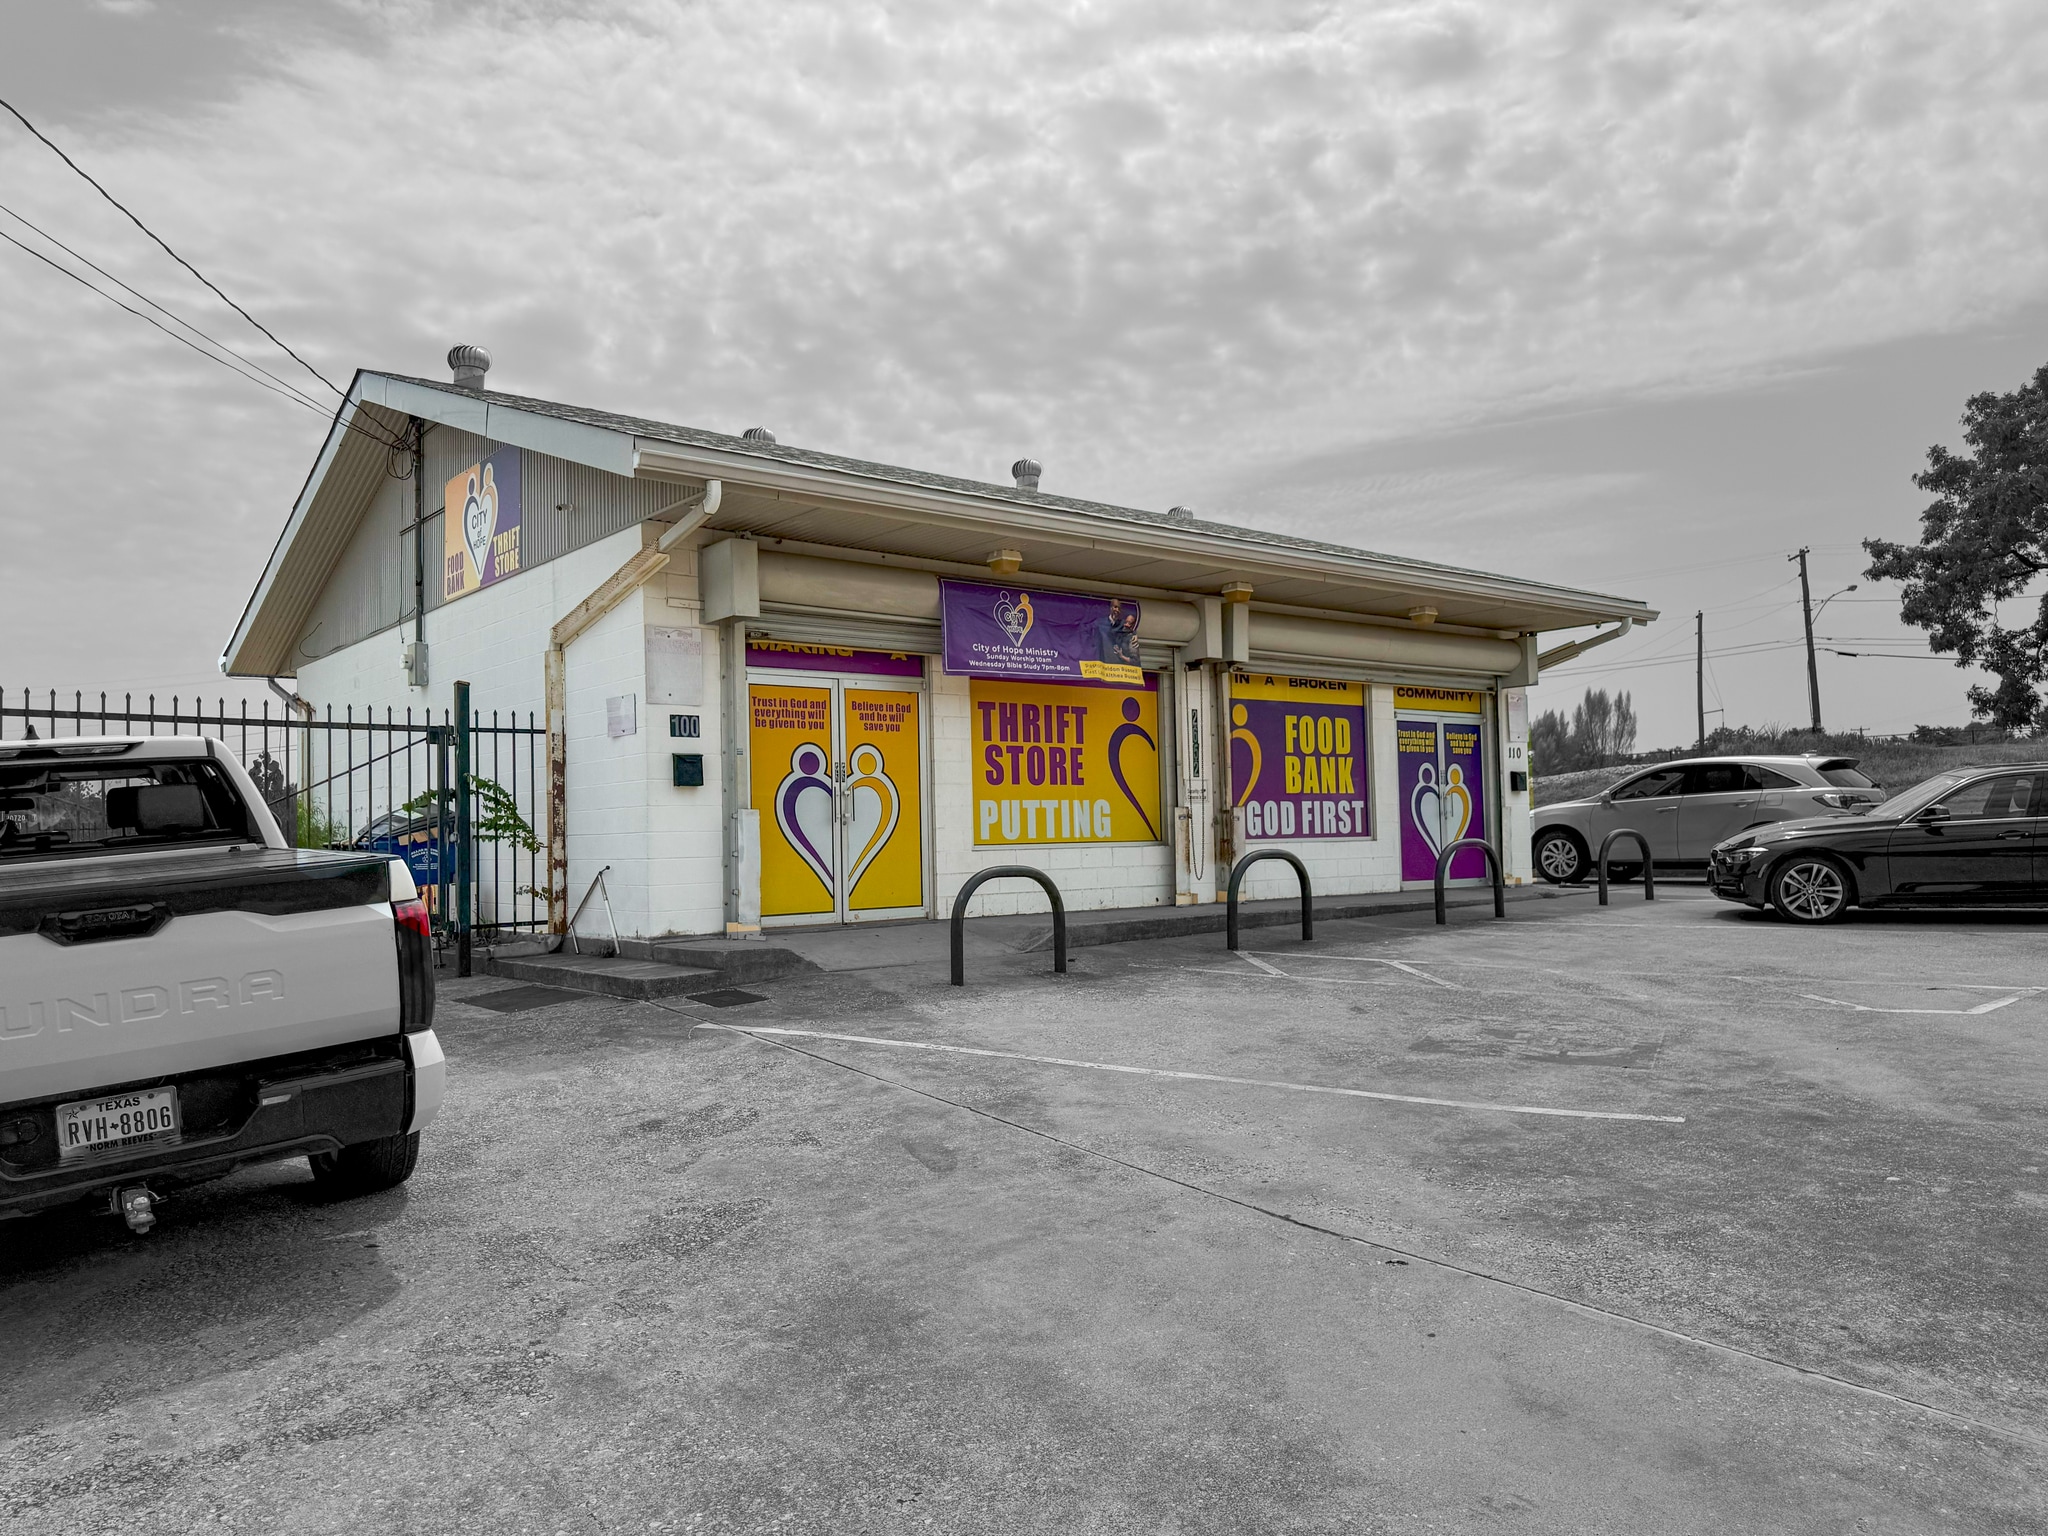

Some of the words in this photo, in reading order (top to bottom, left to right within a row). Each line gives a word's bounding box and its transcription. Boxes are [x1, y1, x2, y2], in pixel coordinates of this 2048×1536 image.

[471, 508, 488, 530] CITY
[473, 535, 486, 550] HOPE
[493, 524, 520, 556] THRIFT
[447, 551, 464, 576] FOOD
[494, 548, 520, 578] STORE
[446, 570, 465, 596] BANK
[1004, 611, 1024, 623] CITY
[972, 643, 990, 654] City
[992, 644, 1000, 652] of
[1002, 645, 1024, 655] Hope
[1026, 647, 1058, 658] Ministry
[986, 654, 1009, 662] Sunday
[1010, 654, 1034, 663] Worship
[968, 660, 1006, 669] Wednesday
[1023, 663, 1040, 671] Study
[1042, 664, 1070, 672] 7pm-8pm
[1234, 674, 1250, 684] IN
[1264, 676, 1274, 686] A
[1289, 678, 1347, 690] BROKEN
[1396, 686, 1474, 702] COMMUNITY
[752, 696, 776, 707] Trust
[779, 698, 788, 708] in
[790, 698, 808, 709] God
[810, 700, 826, 710] and
[852, 701, 884, 712] Believe
[886, 702, 894, 712] in
[896, 703, 912, 713] God
[754, 708, 806, 720] everything
[808, 710, 825, 720] will
[859, 712, 875, 721] and
[876, 712, 888, 722] he
[888, 712, 904, 722] will
[671, 716, 699, 737] 100
[755, 718, 768, 728] be
[769, 718, 795, 730] given
[797, 720, 806, 729] to
[808, 720, 825, 730] you
[864, 722, 884, 732] save
[885, 723, 900, 732] you
[977, 701, 1088, 744] THRIFT
[1284, 714, 1350, 755] FOOD
[1508, 747, 1522, 759] 110
[984, 744, 1085, 786] STORE
[1284, 756, 1355, 794] BANK
[979, 798, 1112, 840] PUTTING
[1246, 800, 1296, 836] GOD
[1302, 800, 1364, 835] FIRST
[0, 969, 284, 1040] UNDRA
[96, 1096, 140, 1112] TEXAS
